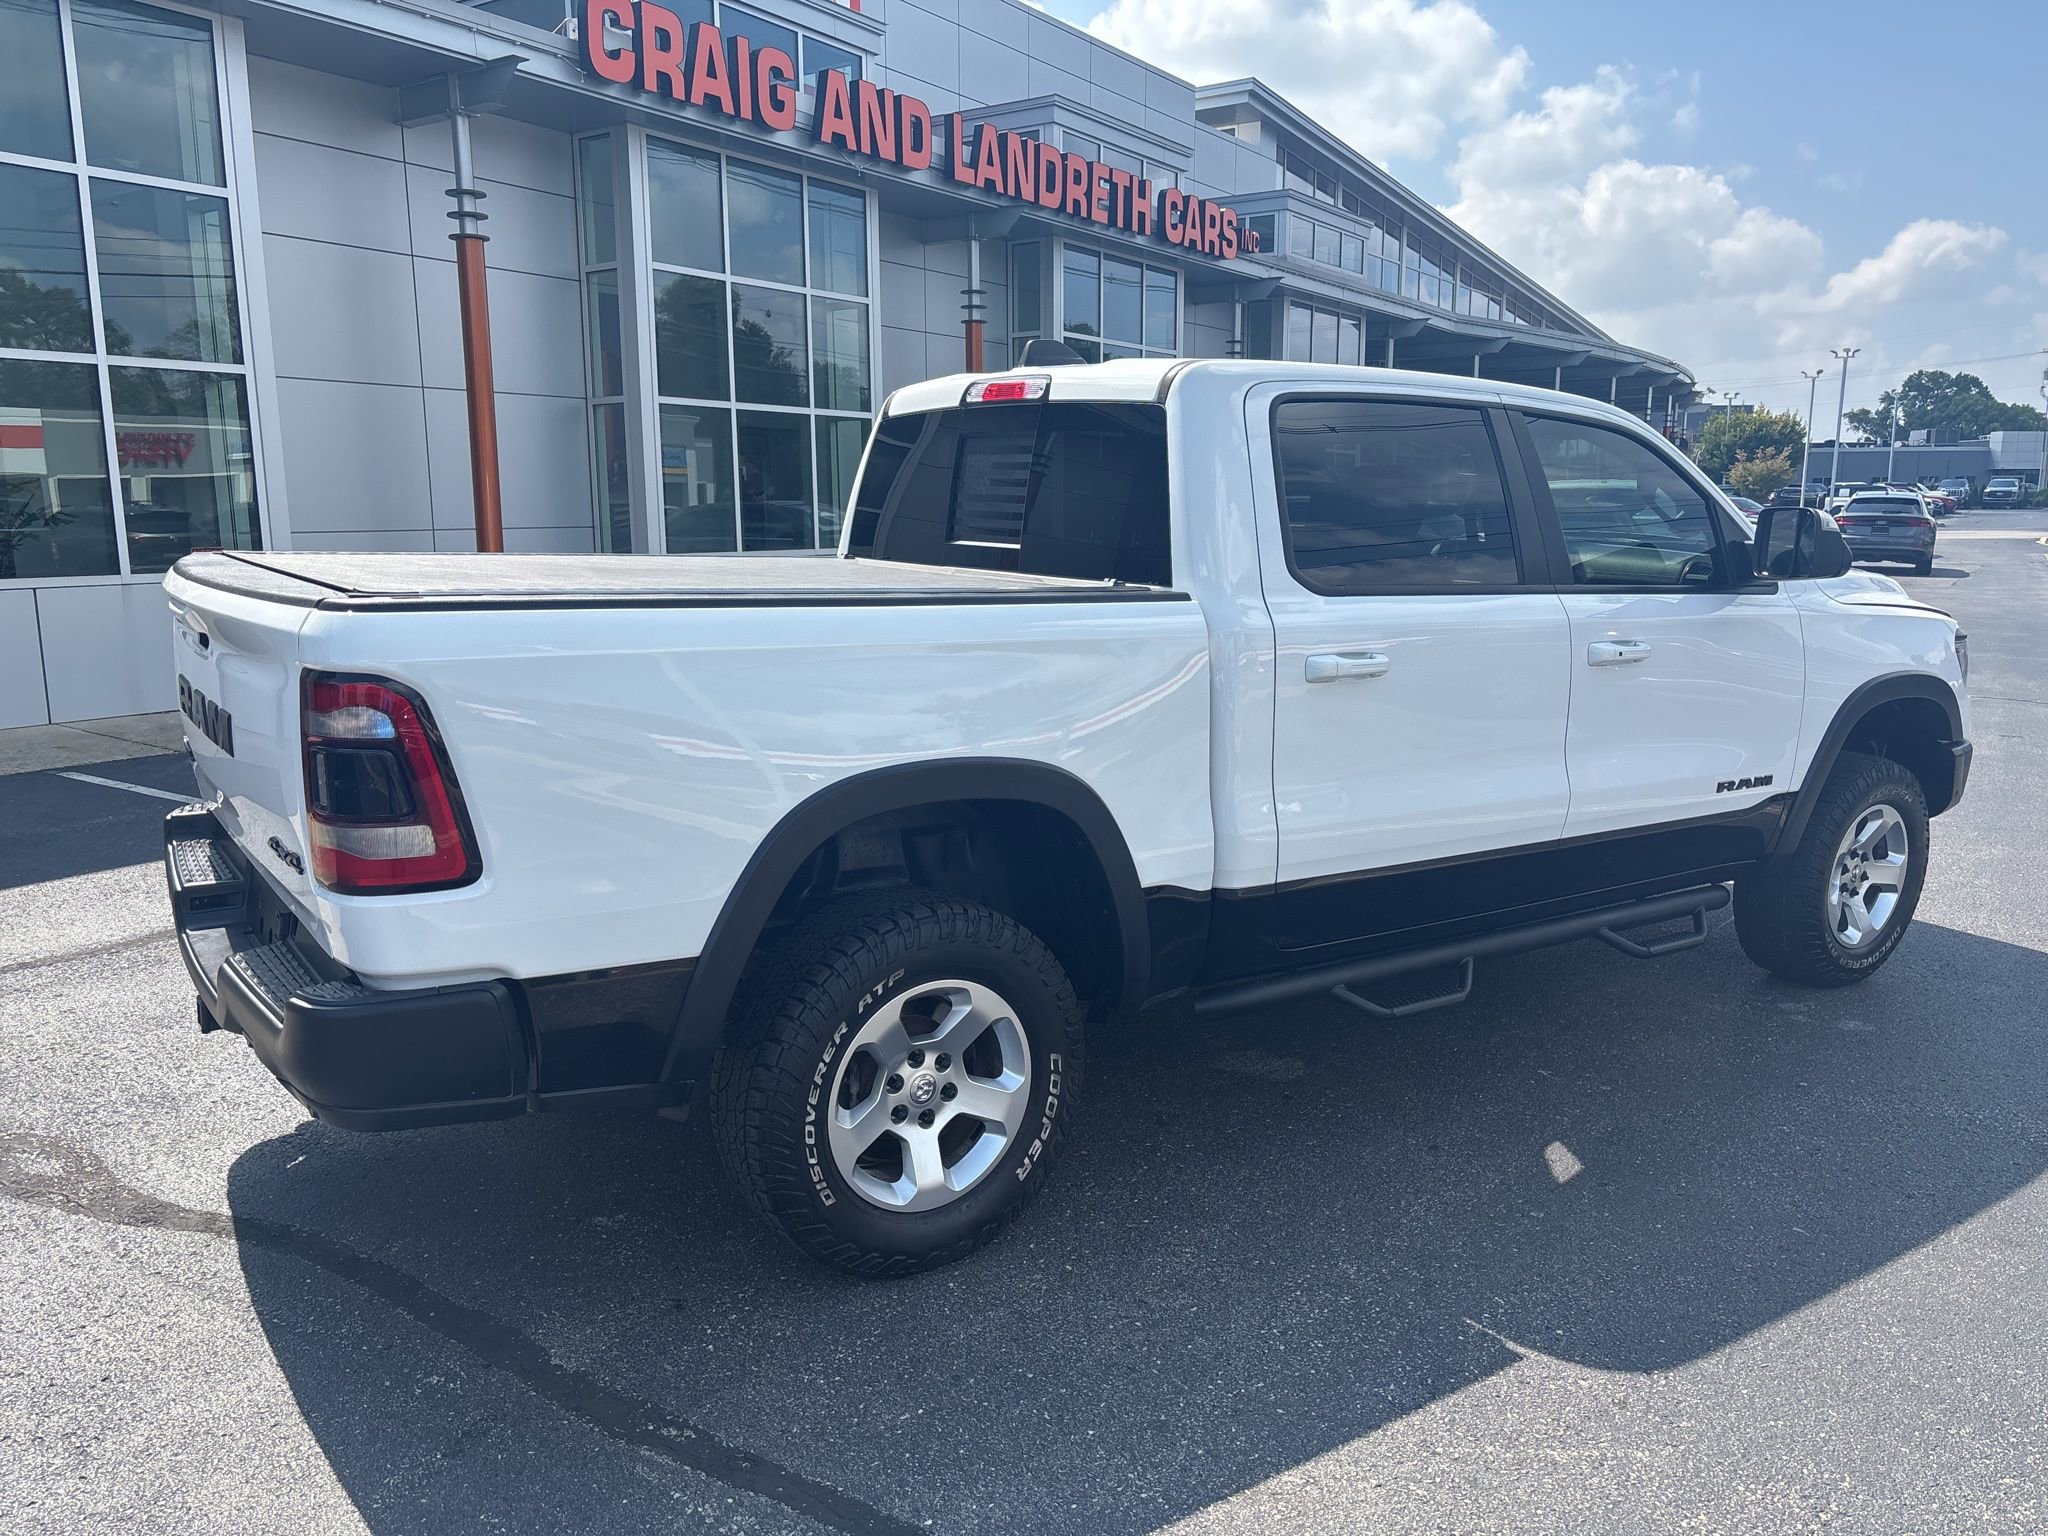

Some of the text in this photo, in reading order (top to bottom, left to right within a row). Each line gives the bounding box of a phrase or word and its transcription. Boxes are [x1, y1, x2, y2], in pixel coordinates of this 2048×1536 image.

[586, 0, 1260, 260] CRAIG AND LANDRETH CARS INC
[178, 673, 235, 758] RAM
[1715, 774, 1774, 794] RAM
[804, 1021, 849, 1207] DISCOVERER
[1015, 1053, 1064, 1182] COOPER
